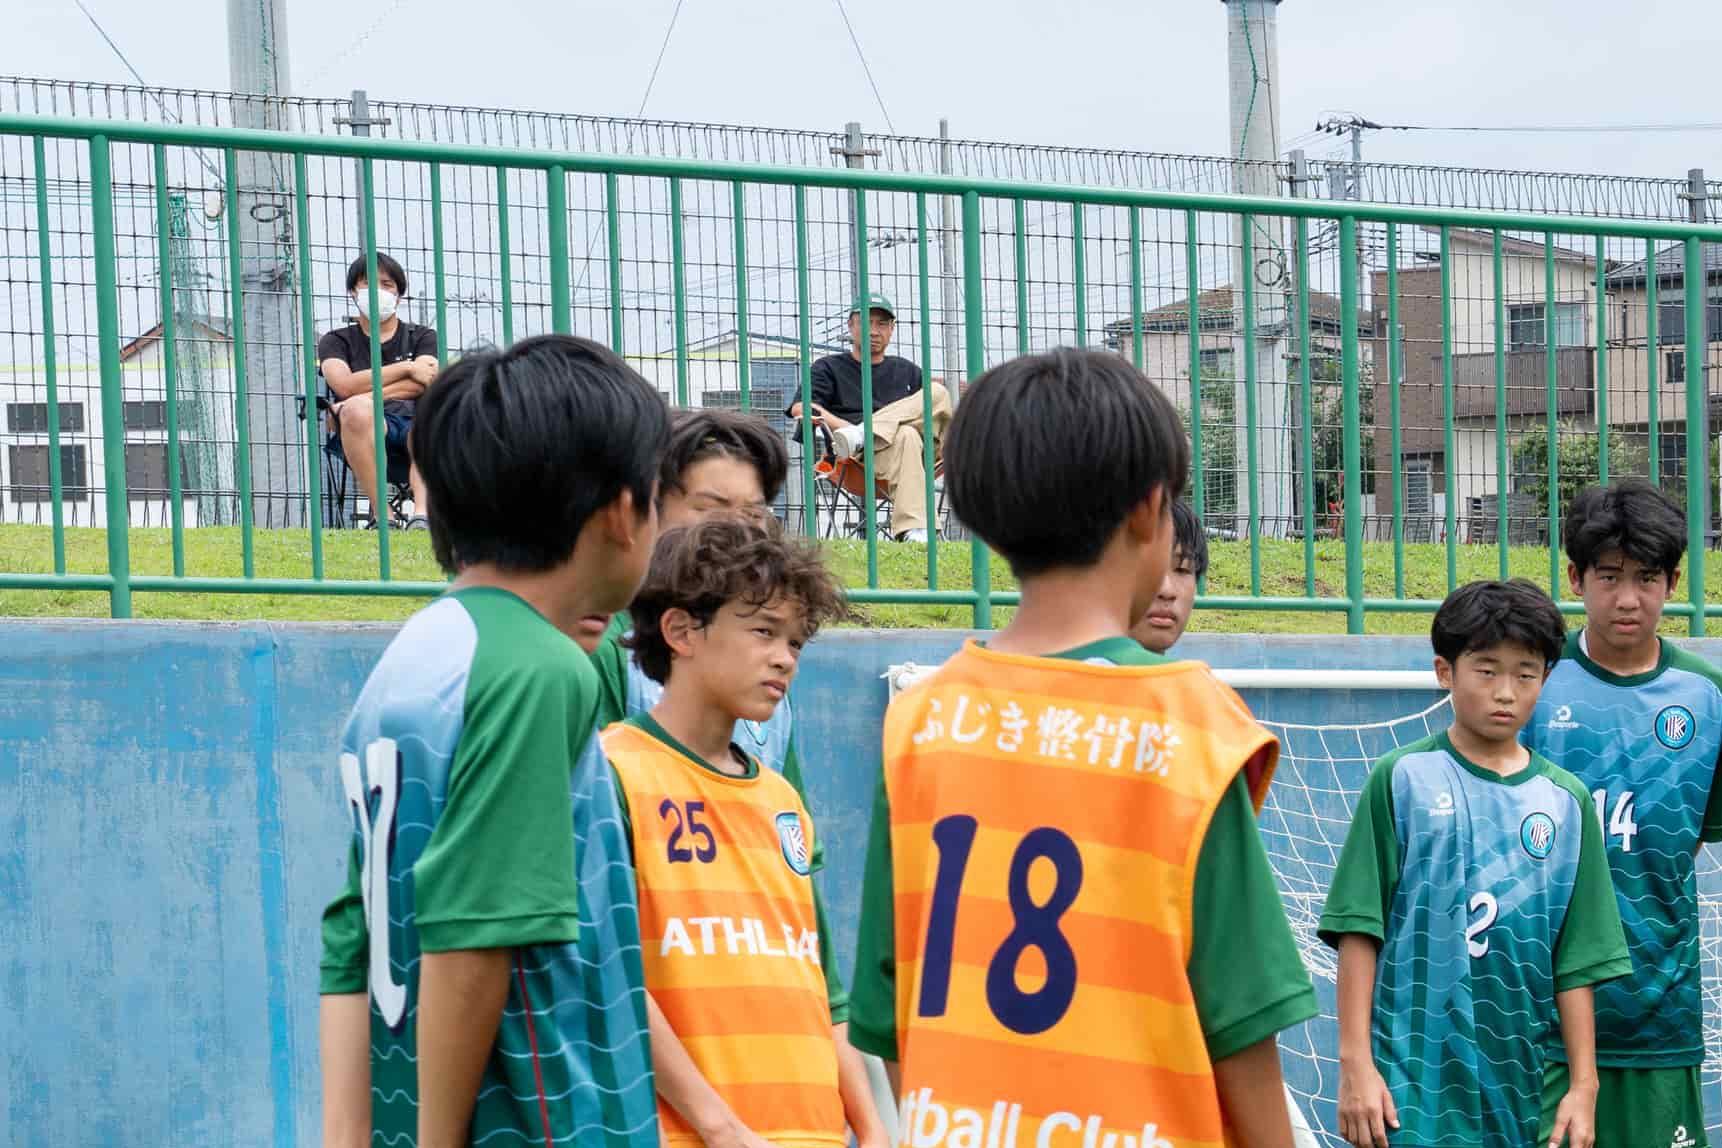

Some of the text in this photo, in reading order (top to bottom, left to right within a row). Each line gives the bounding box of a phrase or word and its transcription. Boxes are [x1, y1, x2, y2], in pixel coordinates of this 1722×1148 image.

[913, 695, 1182, 777] ふじき整骨院
[659, 798, 717, 864] 25
[1593, 789, 1639, 853] 14
[918, 814, 1084, 1035] 18
[1467, 892, 1499, 958] 2
